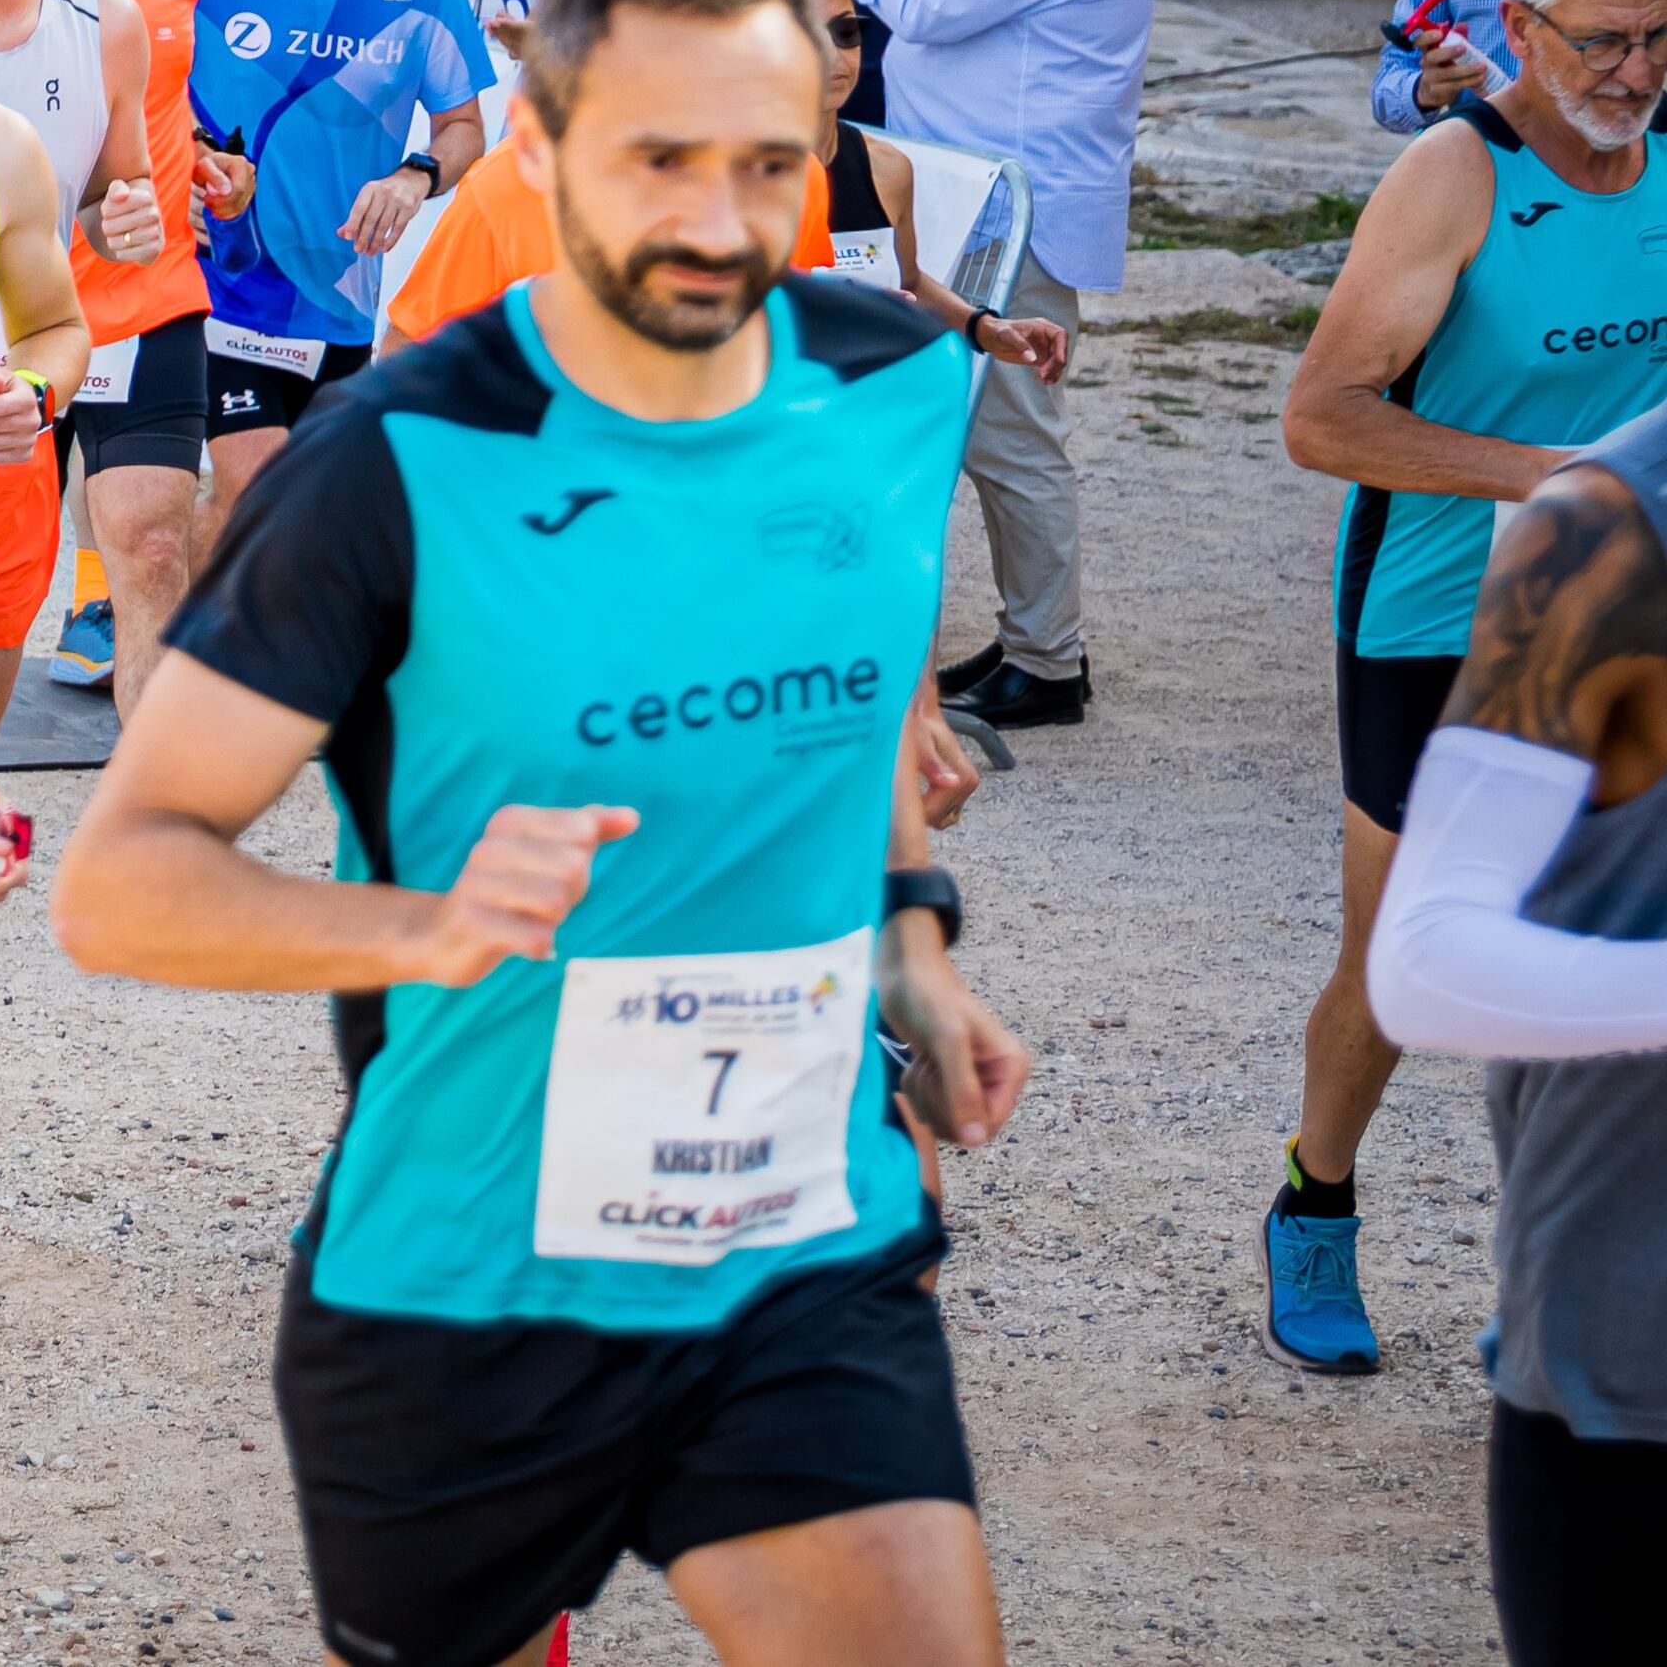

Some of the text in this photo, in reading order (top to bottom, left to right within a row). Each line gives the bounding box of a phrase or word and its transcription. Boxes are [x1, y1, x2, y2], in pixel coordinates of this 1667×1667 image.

[285, 29, 405, 65] ZURICH
[834, 248, 861, 259] LLES
[576, 657, 881, 748] cecome
[654, 990, 700, 1025] 10
[705, 985, 800, 1007] MILLES
[703, 1048, 742, 1117] 7
[651, 1133, 774, 1175] KRISTIAN
